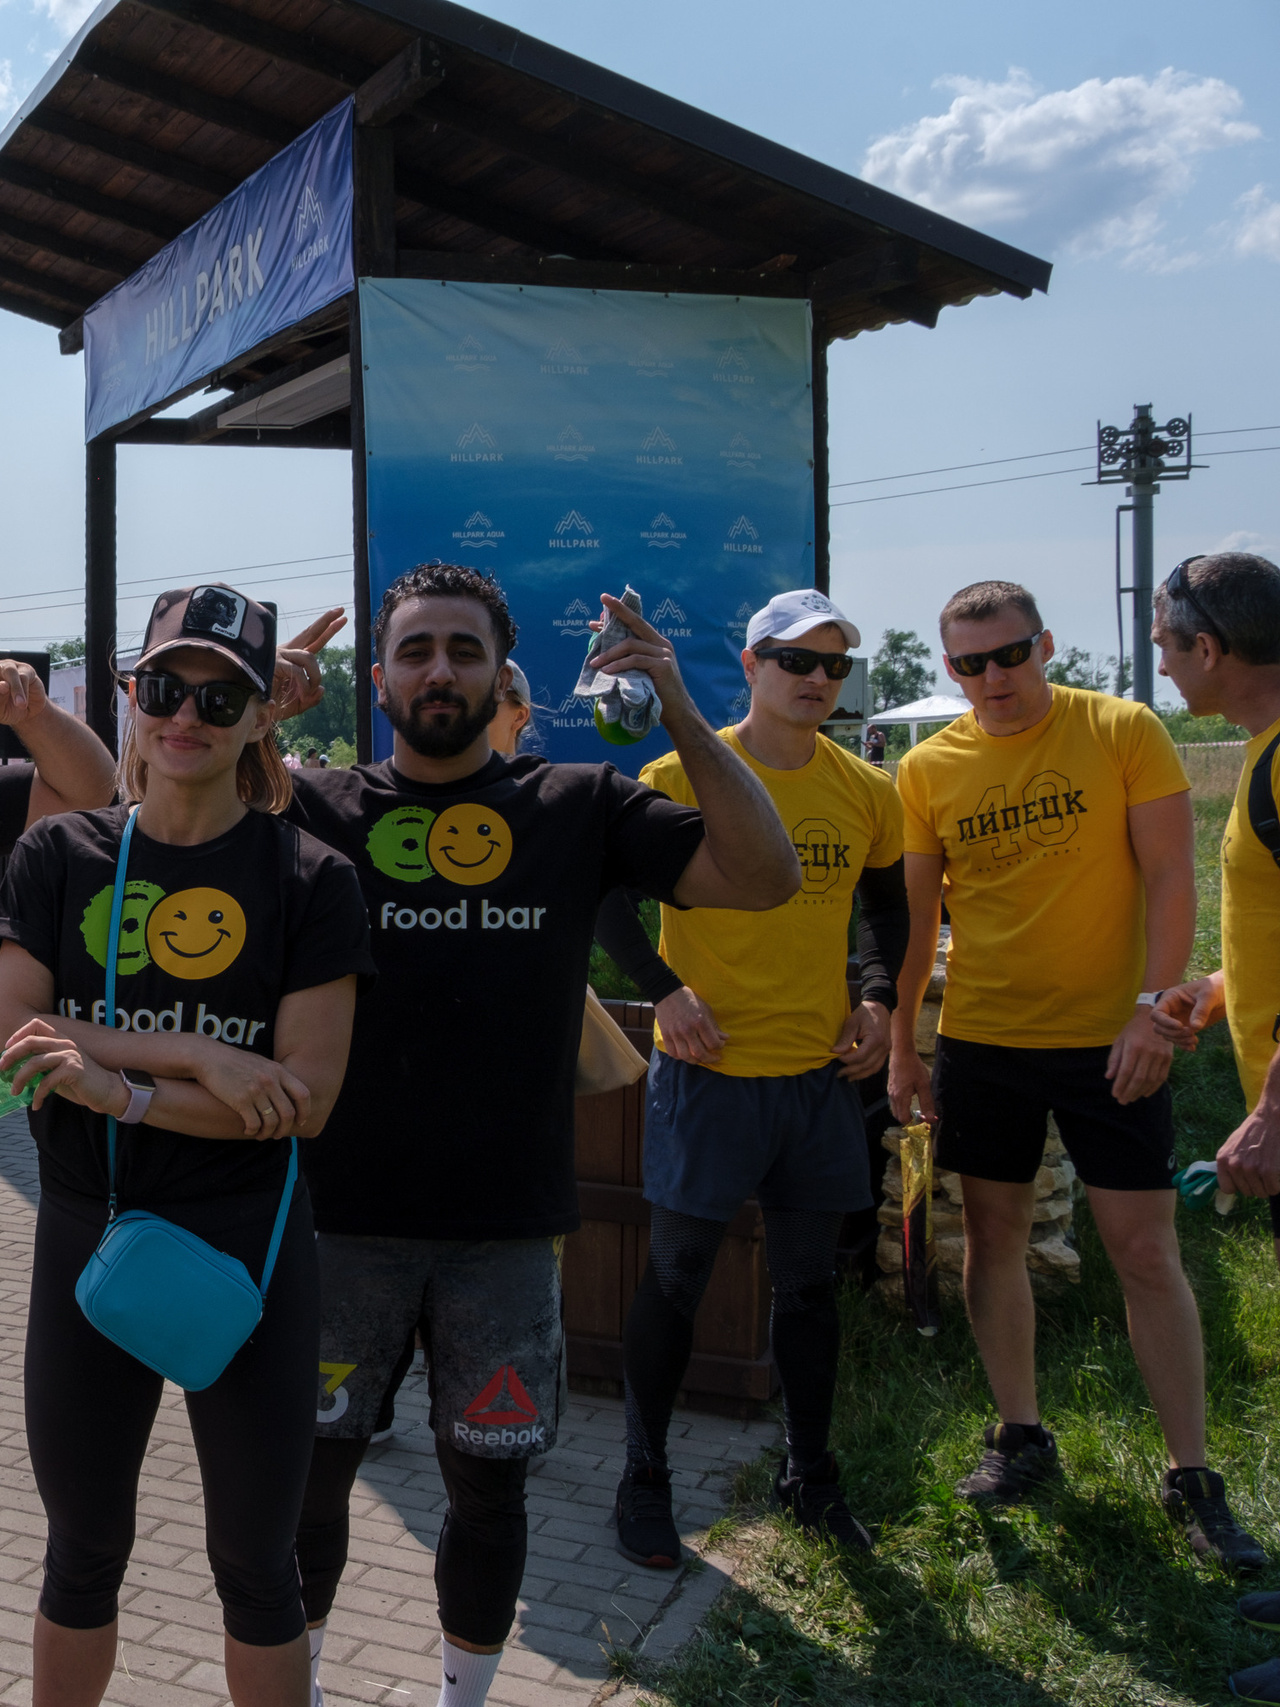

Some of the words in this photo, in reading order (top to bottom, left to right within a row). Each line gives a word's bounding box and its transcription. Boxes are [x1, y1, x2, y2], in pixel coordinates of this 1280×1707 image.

[291, 234, 329, 273] HILLPARK
[146, 226, 264, 365] HILLPARK
[446, 354, 479, 362] HILLPARK
[540, 365, 590, 376] HILLPARK
[712, 373, 756, 384] HILLPARK
[450, 453, 504, 462] HILLPARK
[636, 455, 683, 465] HILLPARK
[452, 531, 485, 539] HILLPARK
[640, 531, 669, 539] HILLPARK
[670, 532, 687, 540] AQUA
[549, 539, 600, 549] HILLPARK
[723, 542, 763, 554] HILLPARK
[552, 718, 597, 728] HILLPAR
[957, 790, 1088, 843] ЛИПЕЦК
[380, 899, 468, 930] food
[481, 899, 547, 930] bar
[91, 1000, 183, 1034] food
[195, 1003, 266, 1046] bar
[453, 1421, 545, 1447] Reebok
